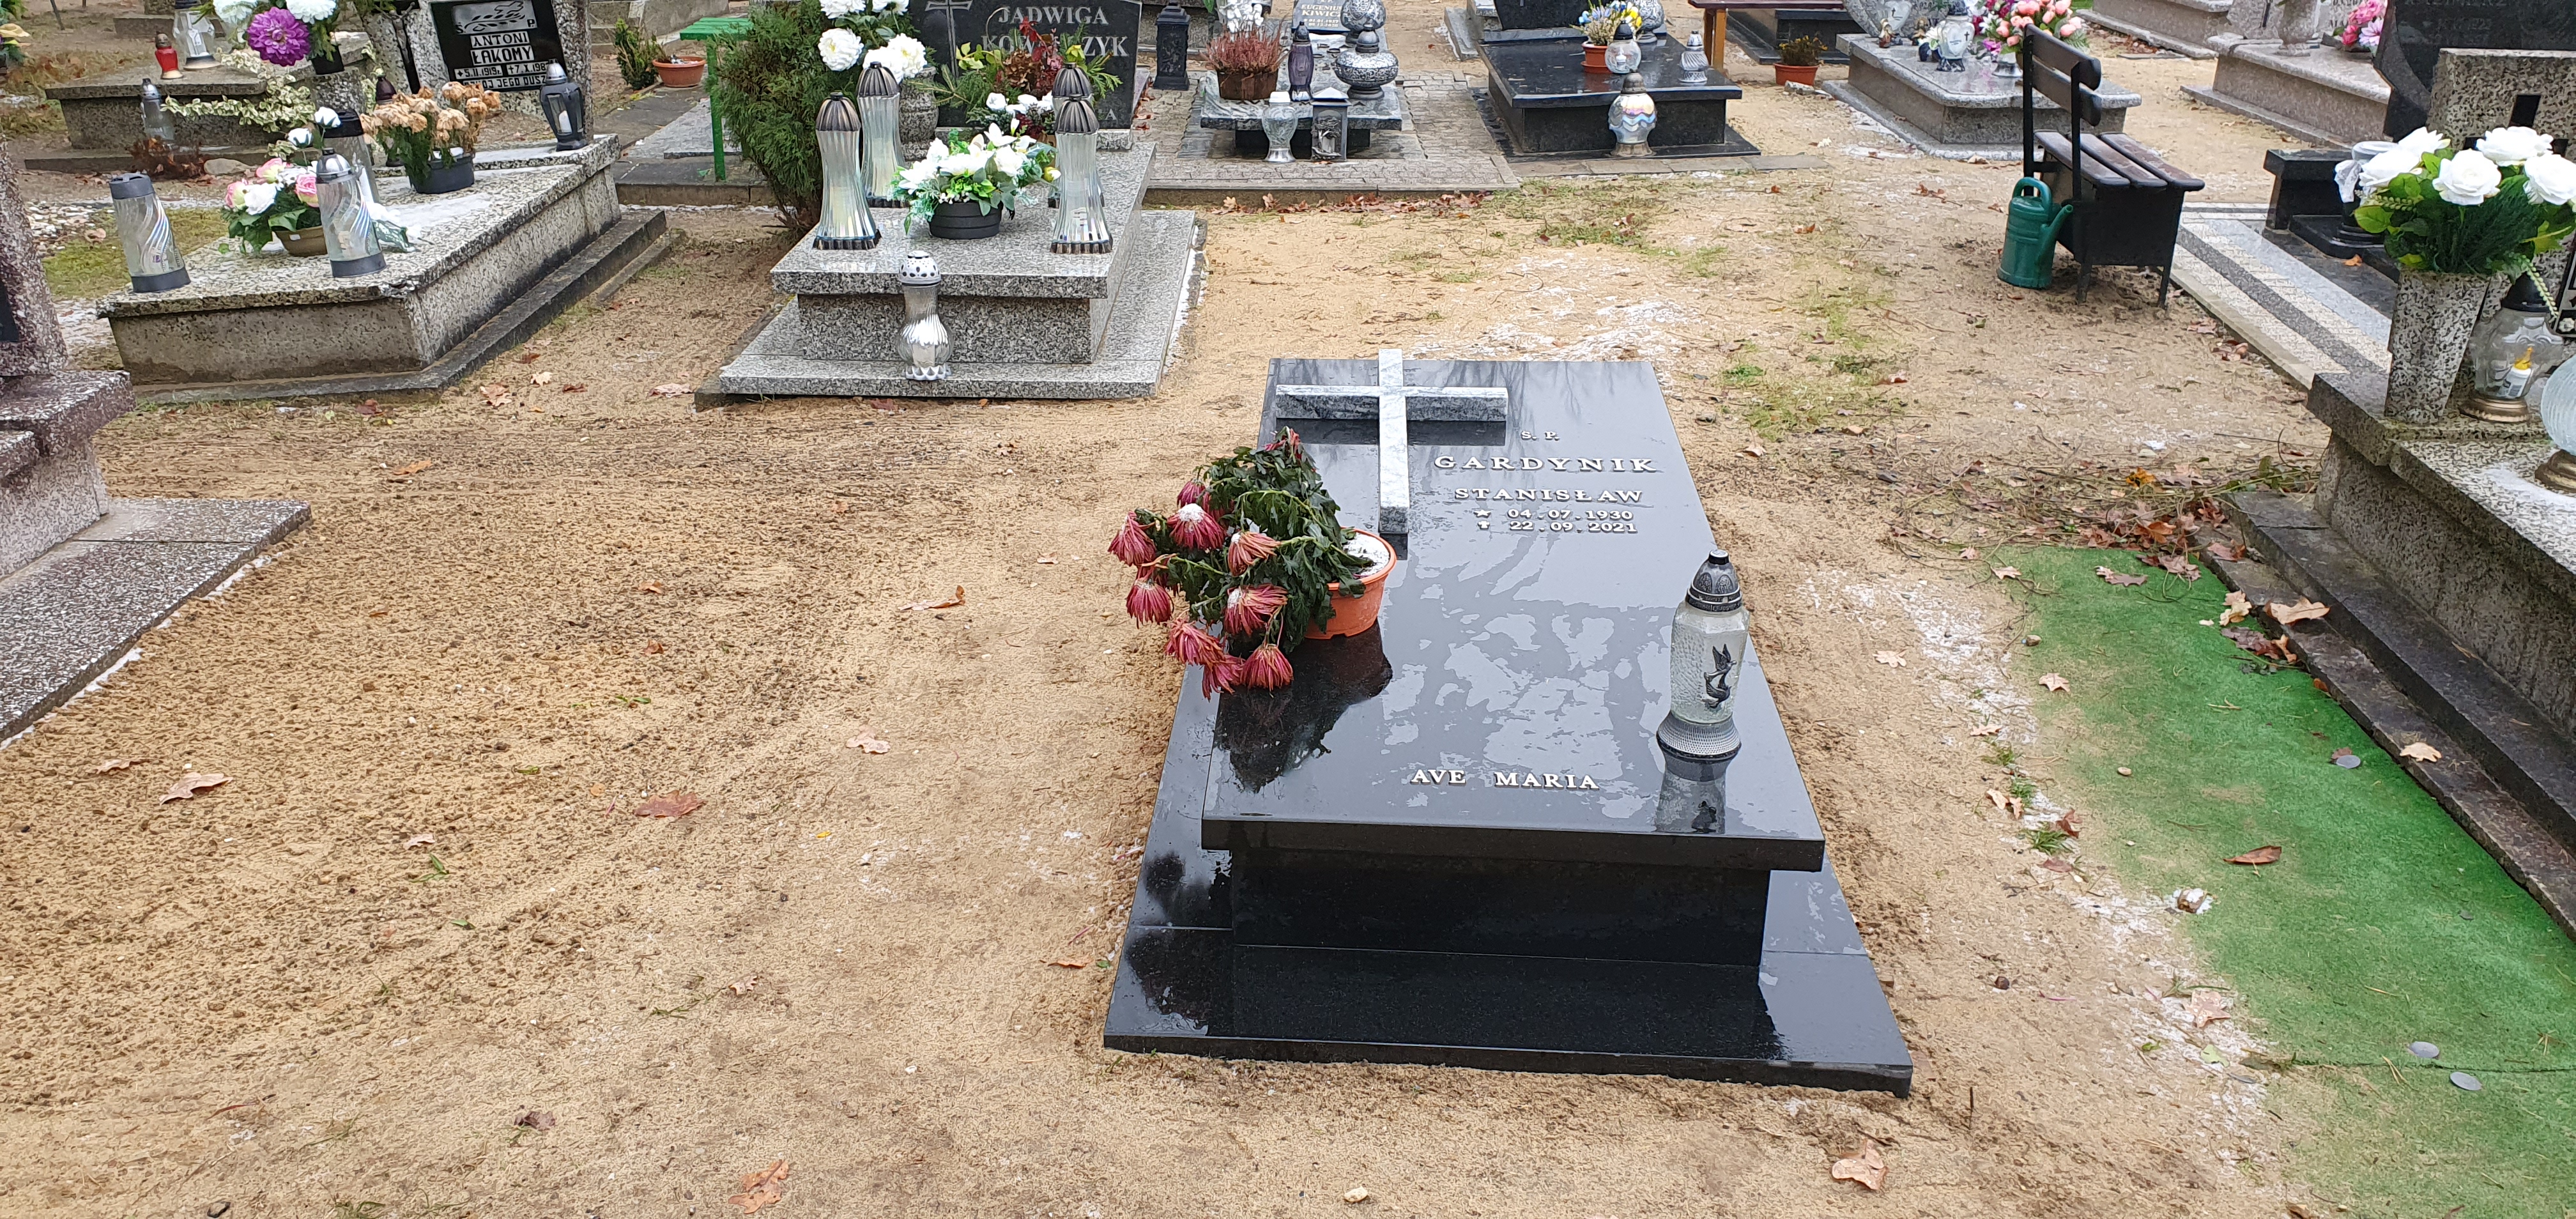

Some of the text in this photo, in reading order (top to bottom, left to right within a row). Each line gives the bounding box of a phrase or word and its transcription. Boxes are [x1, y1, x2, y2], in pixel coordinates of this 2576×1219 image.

[999, 6, 1108, 24] JADWIGA
[474, 33, 528, 47] ANTONI
[981, 36, 1130, 57] KOWZYK
[473, 47, 531, 64] ŁAKOMY
[515, 63, 548, 74] 7.X.198
[524, 75, 547, 85] DUSZ
[1434, 456, 1657, 473] GARDYNIK
[1454, 488, 1642, 503] STANISŁAW
[1409, 769, 1600, 790] AVE MARIA
